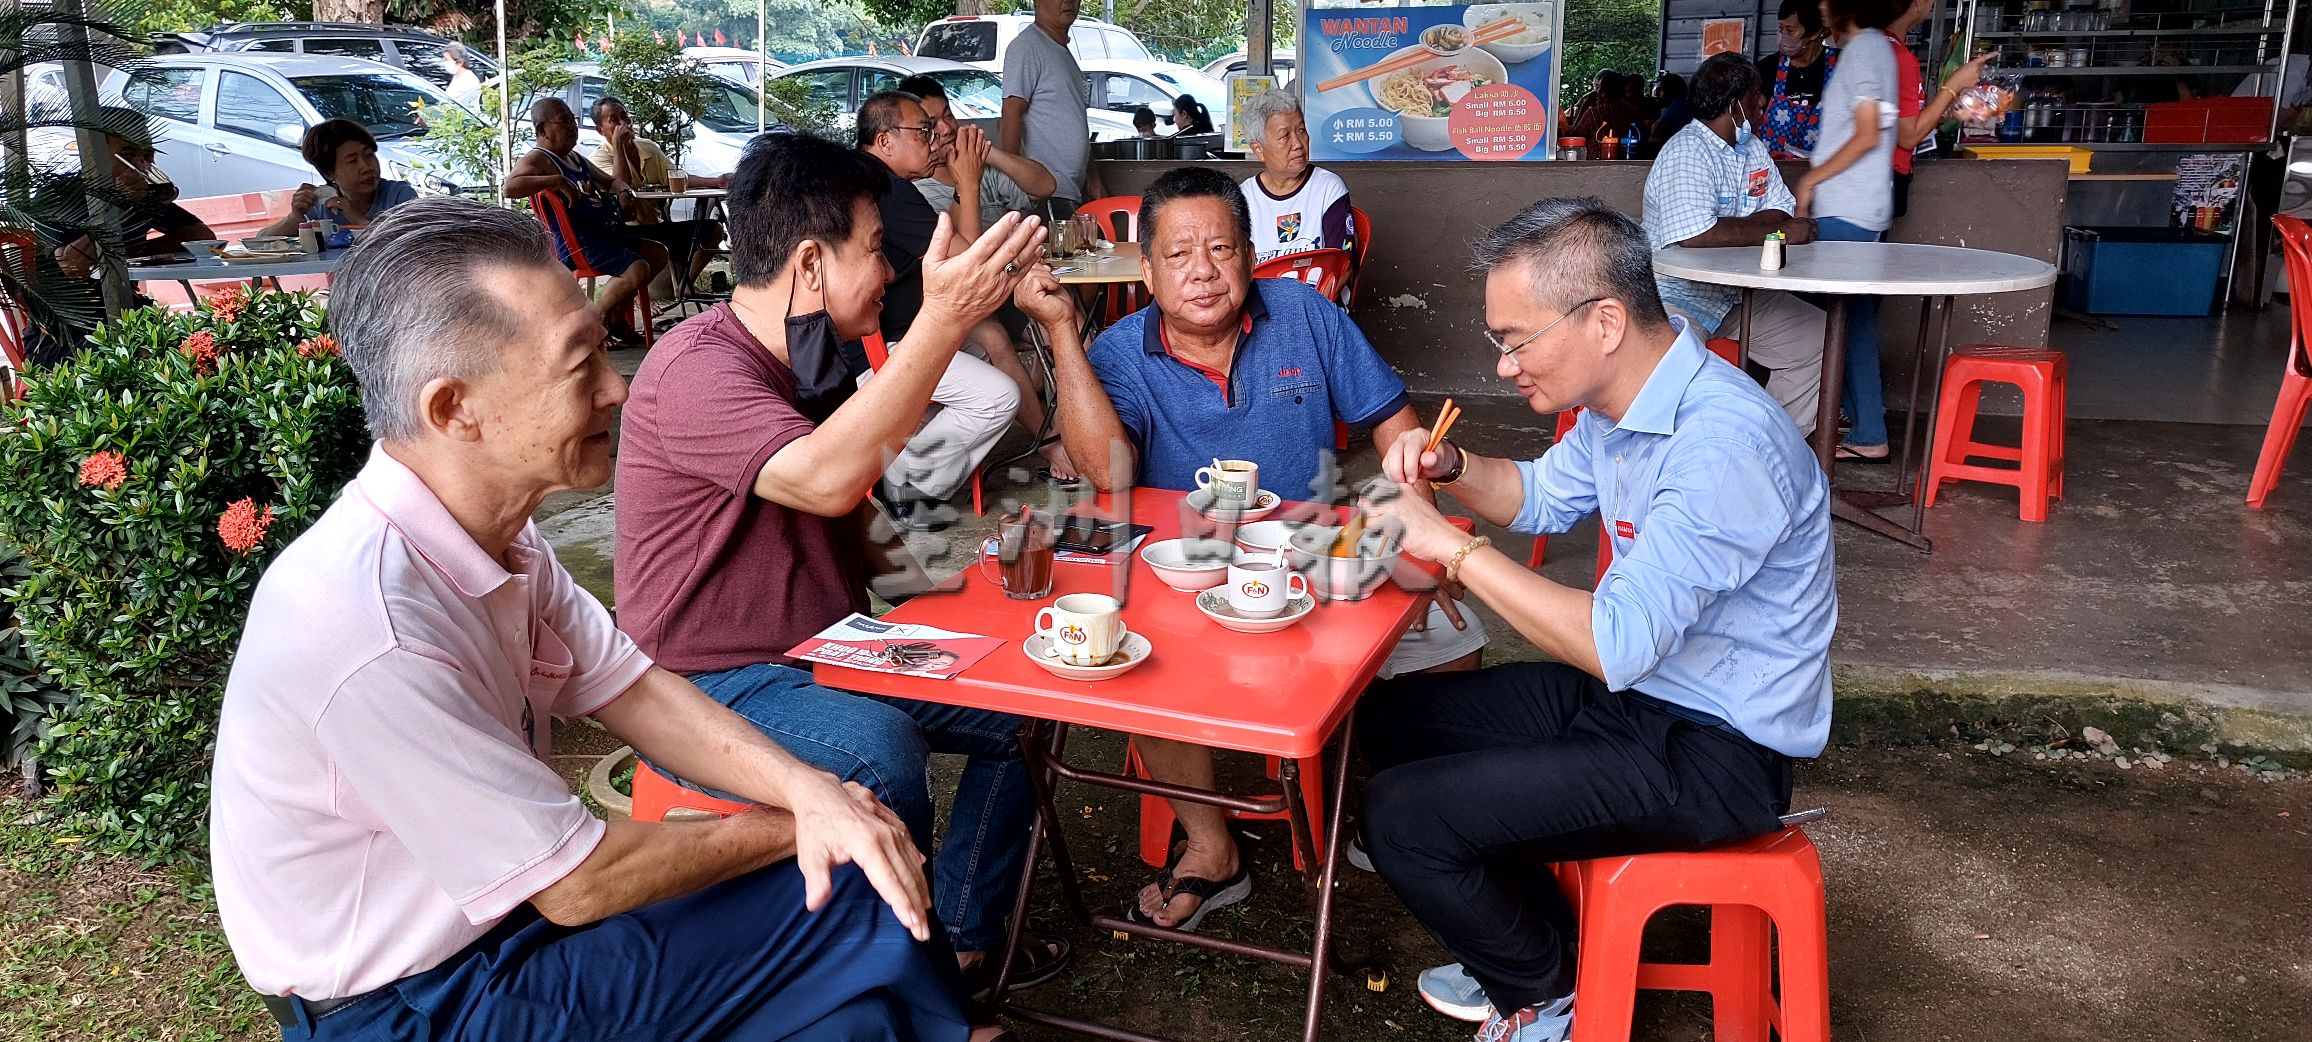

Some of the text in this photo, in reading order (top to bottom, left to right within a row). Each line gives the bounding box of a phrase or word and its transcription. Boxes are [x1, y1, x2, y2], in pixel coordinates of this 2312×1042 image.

[1320, 17, 1408, 36] WANTAN
[1330, 30, 1398, 54] Noodle
[1474, 91, 1499, 99] Laksa
[1465, 99, 1526, 109] Small RM 6.00
[1475, 108, 1526, 118] Big RM 6.50
[1333, 118, 1393, 130] 小 RM 5.00
[1469, 126, 1483, 134] Ball
[1484, 124, 1512, 133] Noodle
[1333, 131, 1393, 143] 大 RM 5.50
[1466, 136, 1489, 145] Small
[1475, 143, 1526, 153] Big RM 5.50
